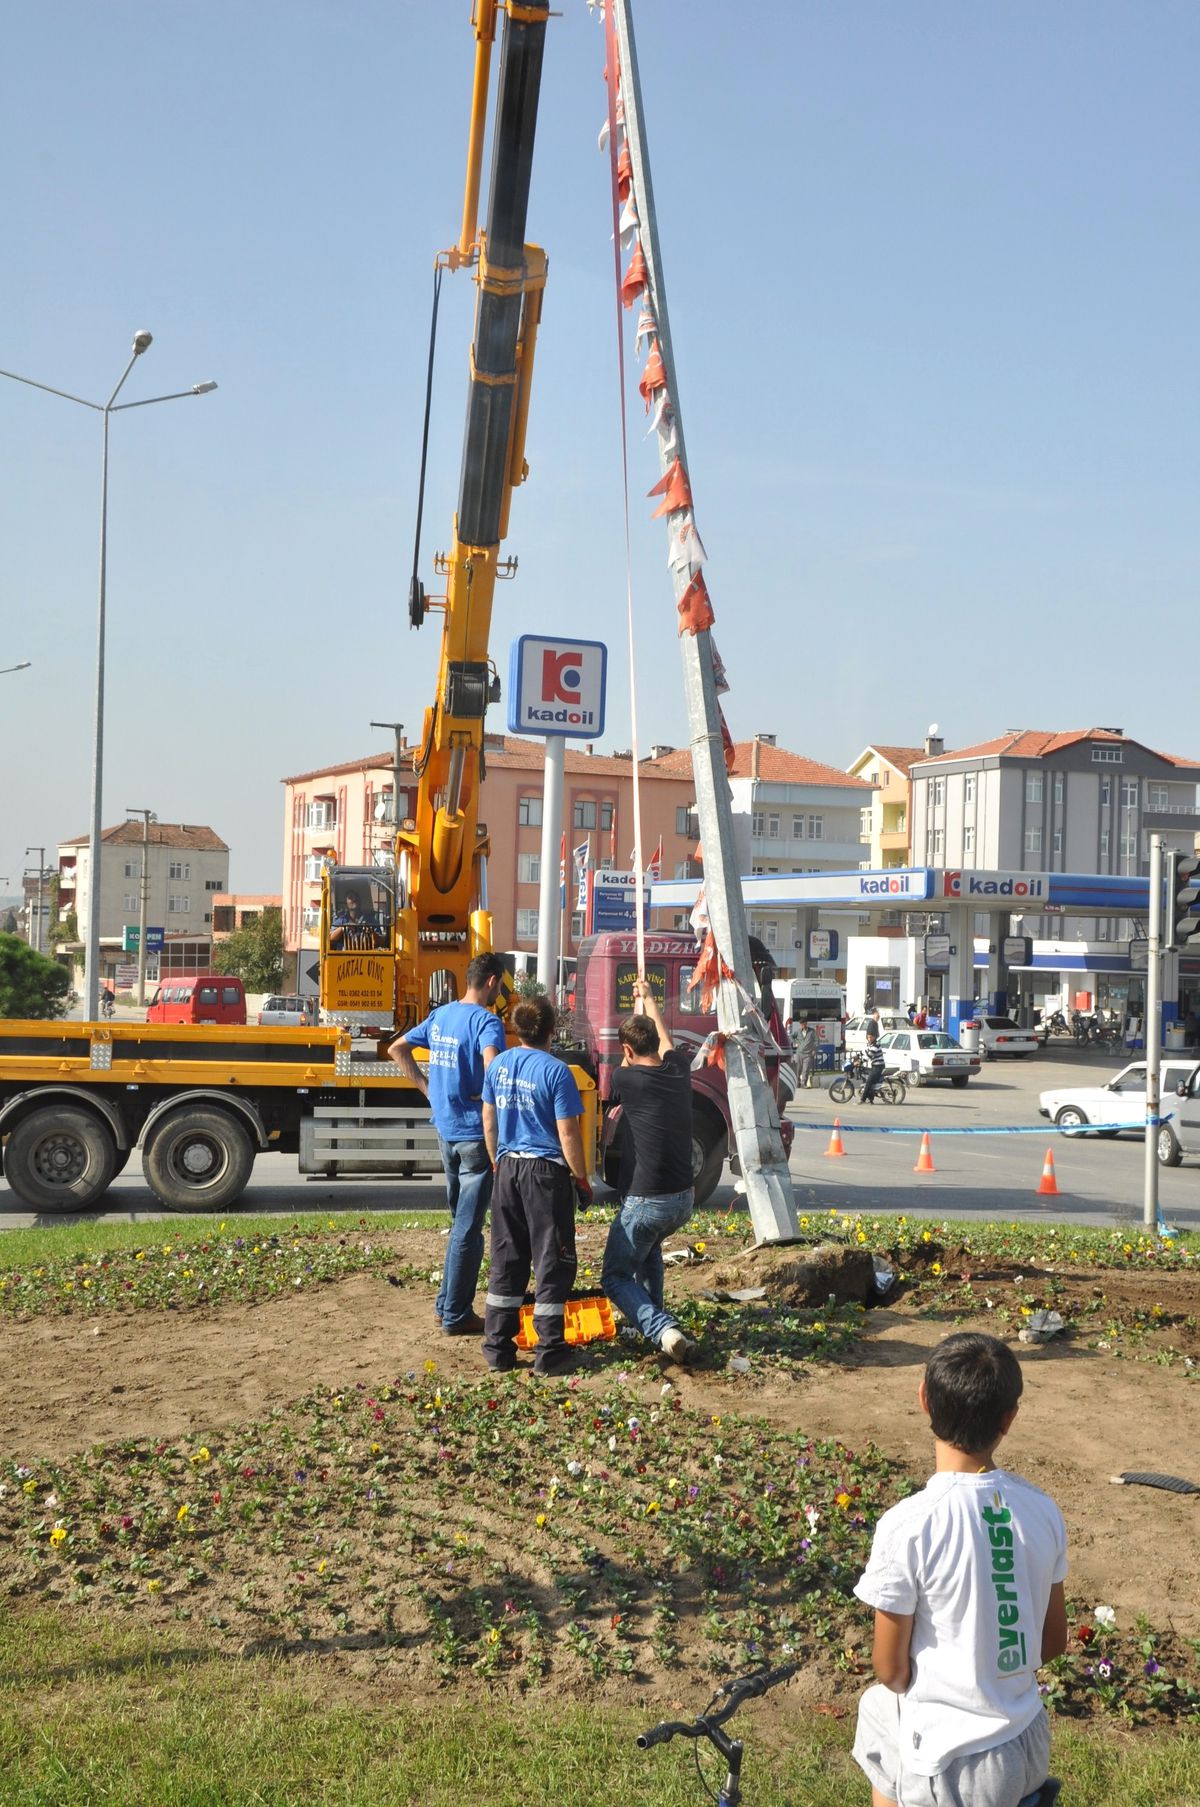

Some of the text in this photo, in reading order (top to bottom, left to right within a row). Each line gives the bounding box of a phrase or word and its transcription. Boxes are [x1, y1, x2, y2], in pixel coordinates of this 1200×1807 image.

[527, 706, 593, 725] kadoil
[602, 874, 645, 885] kadol
[860, 875, 910, 894] kadoil
[969, 876, 1042, 897] kadoil
[336, 958, 363, 984] KARTAL
[617, 973, 637, 985] KART
[982, 1505, 1021, 1672] everlast
